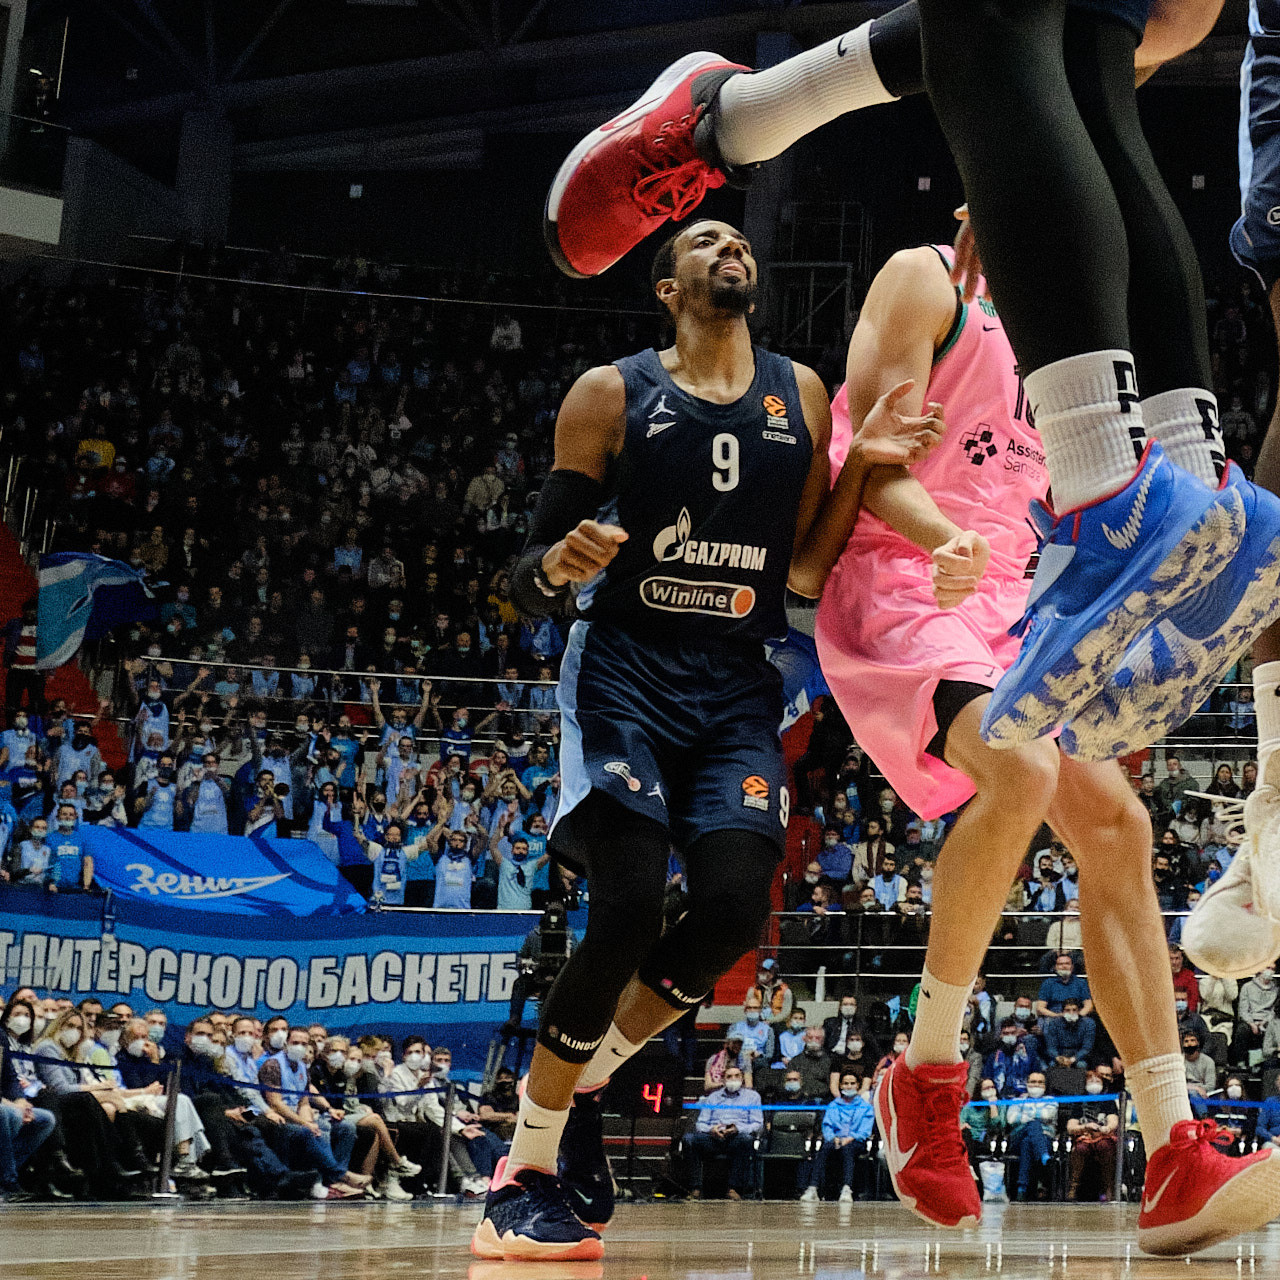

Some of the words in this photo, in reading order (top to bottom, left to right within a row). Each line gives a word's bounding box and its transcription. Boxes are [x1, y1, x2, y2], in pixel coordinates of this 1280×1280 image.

[711, 432, 740, 493] 9
[683, 540, 767, 571] GAZPROM
[650, 582, 728, 609] Winline
[779, 786, 790, 829] 9
[125, 863, 292, 900] Зенит
[19, 933, 298, 1010] ПИТЕРСКОГО
[642, 1083, 664, 1113] 4
